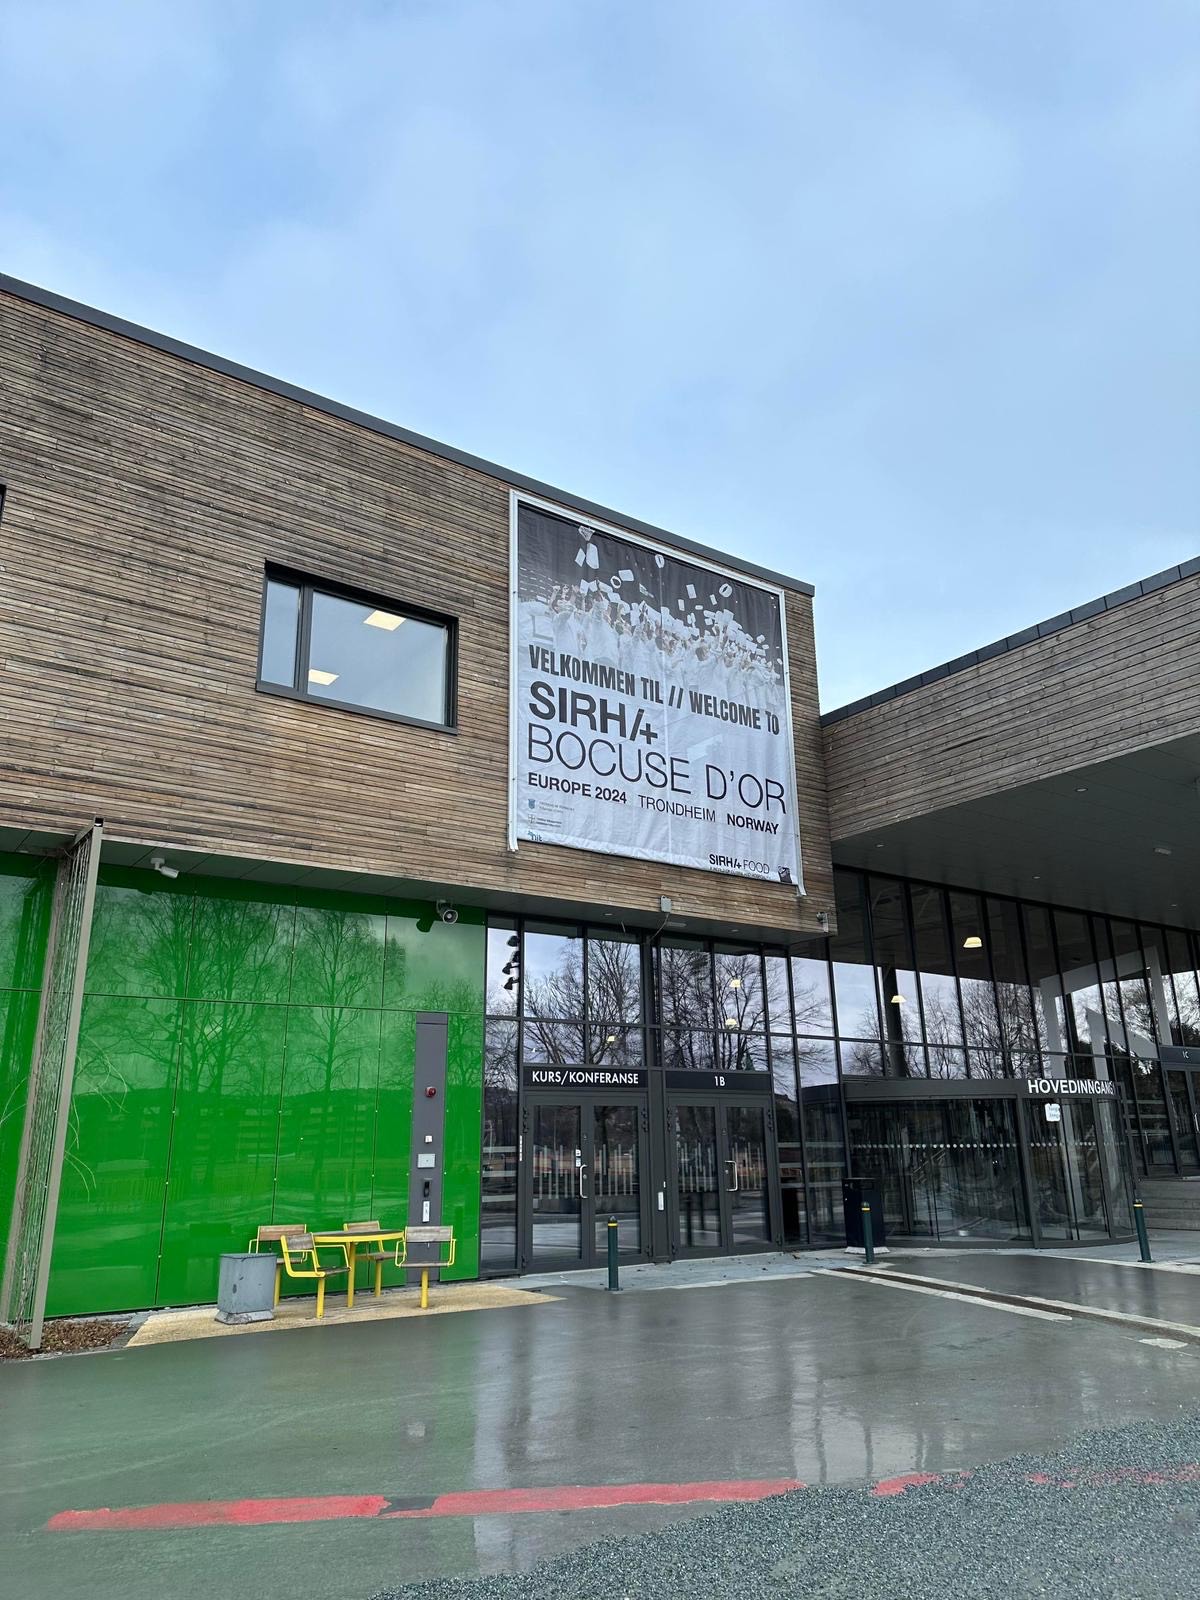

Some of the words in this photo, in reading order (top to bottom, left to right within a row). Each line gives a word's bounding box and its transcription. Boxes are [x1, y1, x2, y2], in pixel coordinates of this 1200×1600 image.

[528, 644, 636, 697] VELKOMMEN
[641, 676, 664, 704] TIL
[689, 690, 761, 730] WELCOME
[765, 710, 780, 736] TO
[528, 723, 692, 795] BOCUSE
[705, 764, 787, 814] D'OR
[528, 772, 592, 797] EUROPE
[595, 786, 628, 804] 2024
[638, 794, 716, 822] TRONDHEIM
[727, 813, 779, 835] NORWAY
[743, 859, 770, 875] FOOD
[532, 1070, 639, 1086] KURS/KONFERANSE
[714, 1075, 726, 1087] 1B
